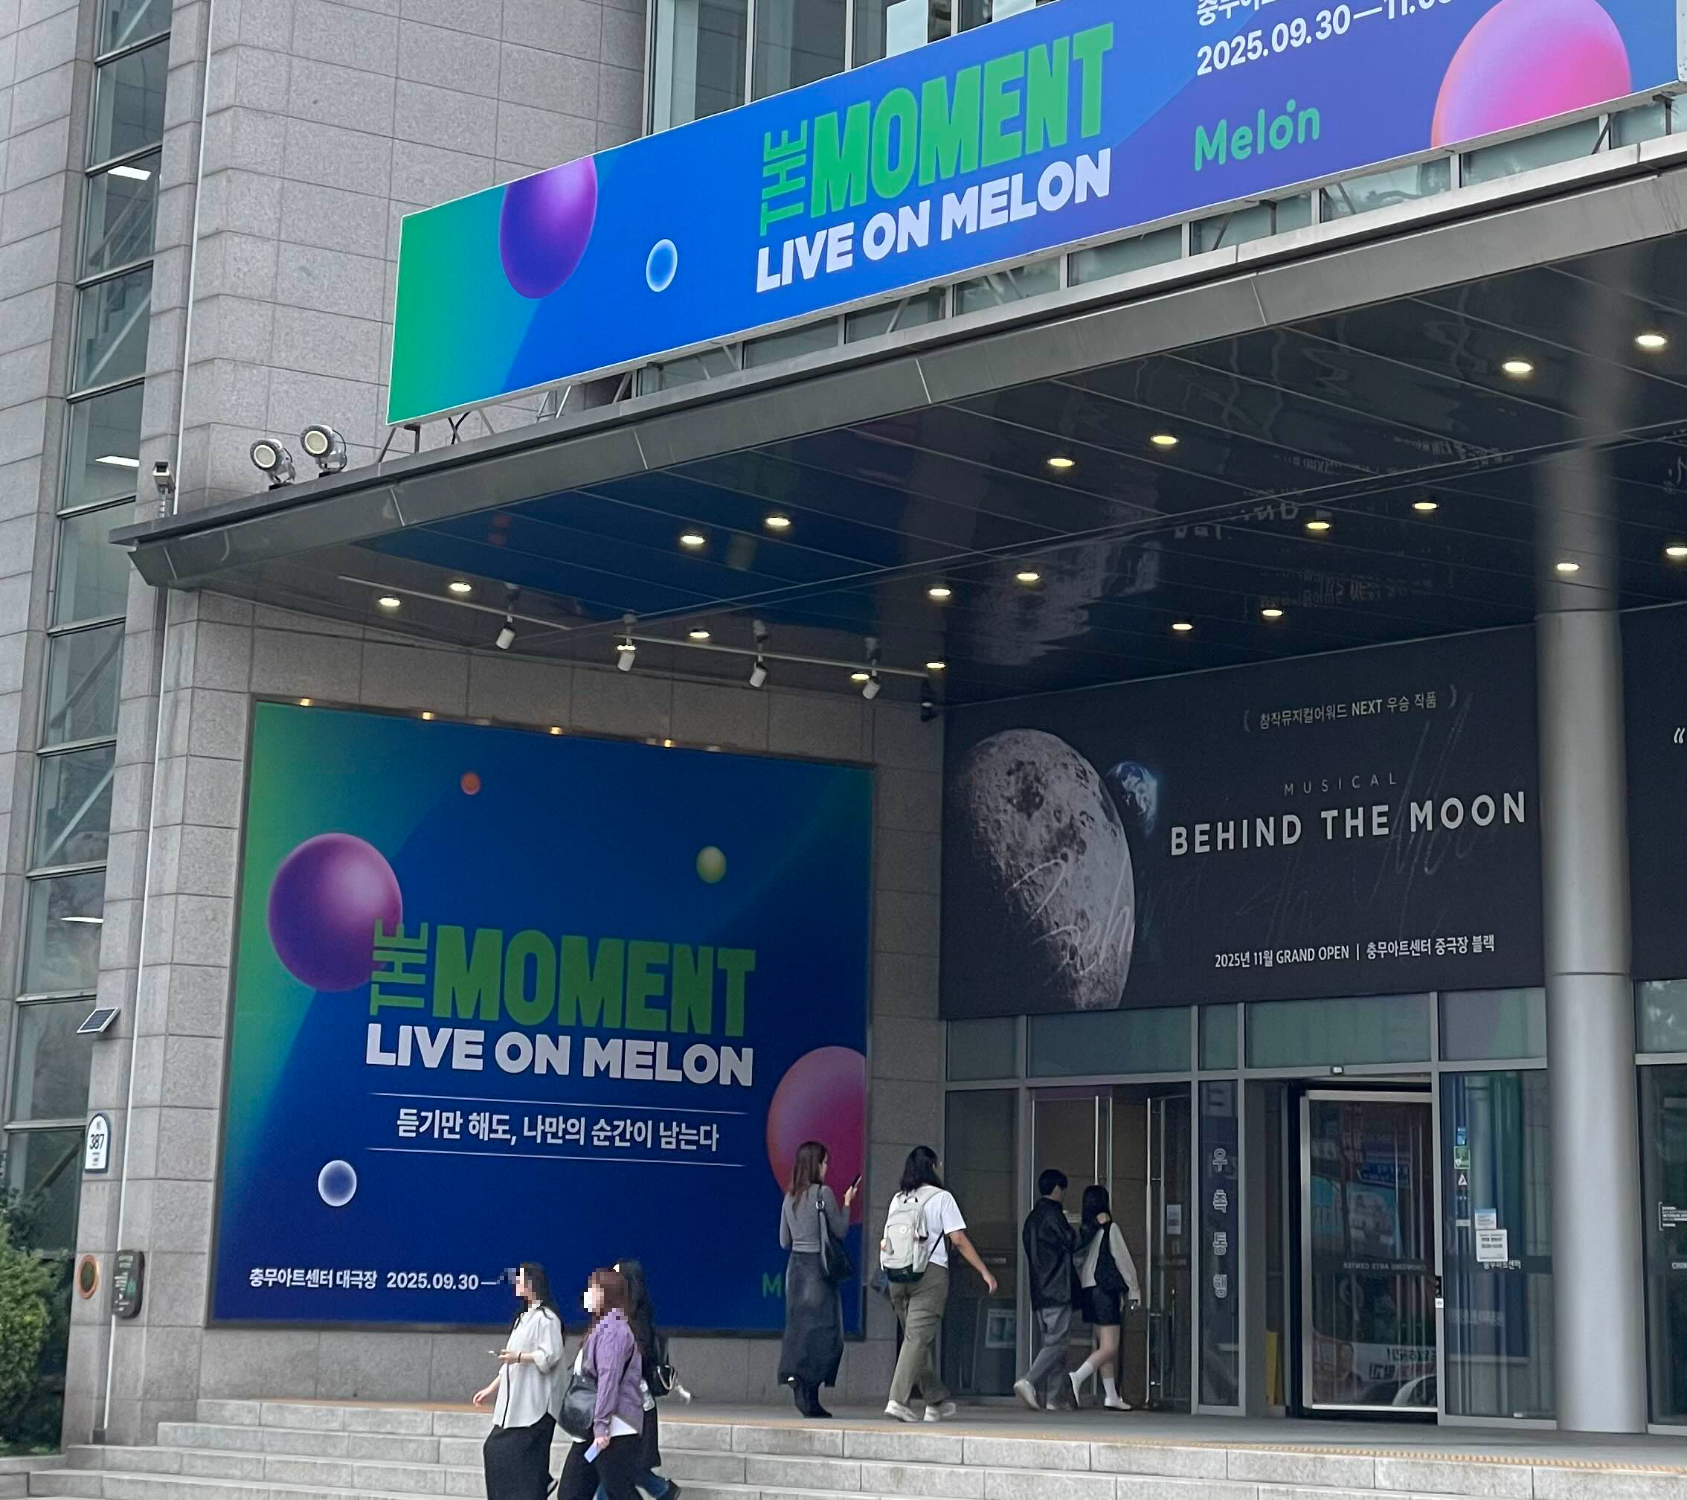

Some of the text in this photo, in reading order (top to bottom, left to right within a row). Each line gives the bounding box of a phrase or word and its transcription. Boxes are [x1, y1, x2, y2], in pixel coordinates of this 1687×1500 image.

[759, 22, 1114, 237] THE MOMENT
[1194, 99, 1320, 171] Melon
[756, 147, 1112, 293] LIVE ON MELON
[1260, 703, 1348, 730] 창작뮤지컬어워드
[1352, 700, 1383, 716] NEXT
[1387, 696, 1410, 713] 우승
[1284, 772, 1397, 796] MUSICAL
[1171, 791, 1525, 856] BEHIND THE MOON
[369, 918, 757, 1037] THE MOMENT
[1215, 950, 1250, 968] 2025년
[1253, 949, 1273, 967] 11월
[1276, 948, 1315, 965] GRAND
[1318, 945, 1350, 961] OPEN
[1366, 938, 1431, 960] 충무아트센터
[1434, 935, 1468, 956] 중극장
[1472, 934, 1495, 952] 블랙
[366, 1023, 754, 1087] LIVE ON MELON
[396, 1108, 720, 1152] 듣기만 해도, 나만의 순간이 남는다
[249, 1268, 333, 1289] 충무아트센터
[336, 1270, 377, 1289] 대극장
